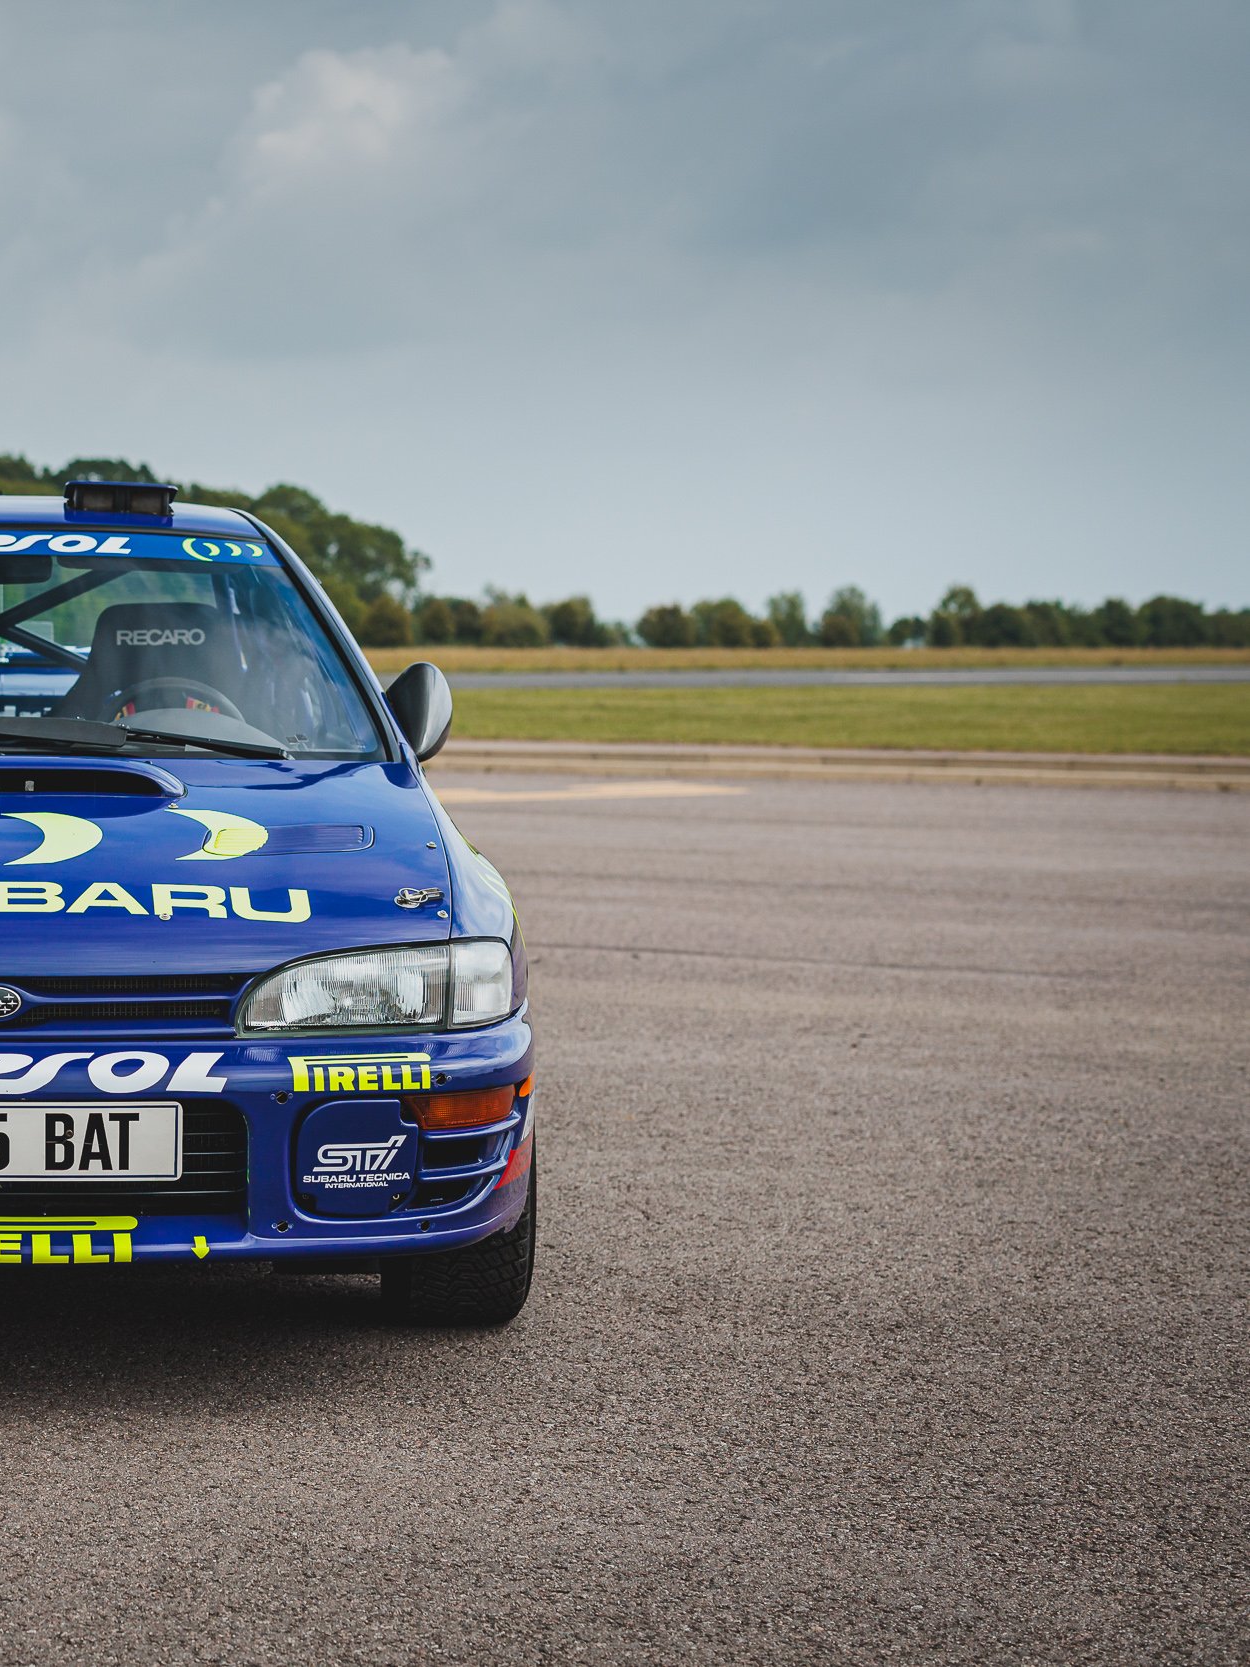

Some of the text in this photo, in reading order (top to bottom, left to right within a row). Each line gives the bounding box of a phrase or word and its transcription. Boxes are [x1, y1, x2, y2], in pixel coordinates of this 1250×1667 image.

[116, 628, 206, 647] RECARO
[287, 1052, 432, 1092] PIRELLI
[45, 1112, 140, 1171] BAT
[302, 1171, 411, 1184] SUBARU TECNICA
[324, 1180, 389, 1190] INTERNATIONAL
